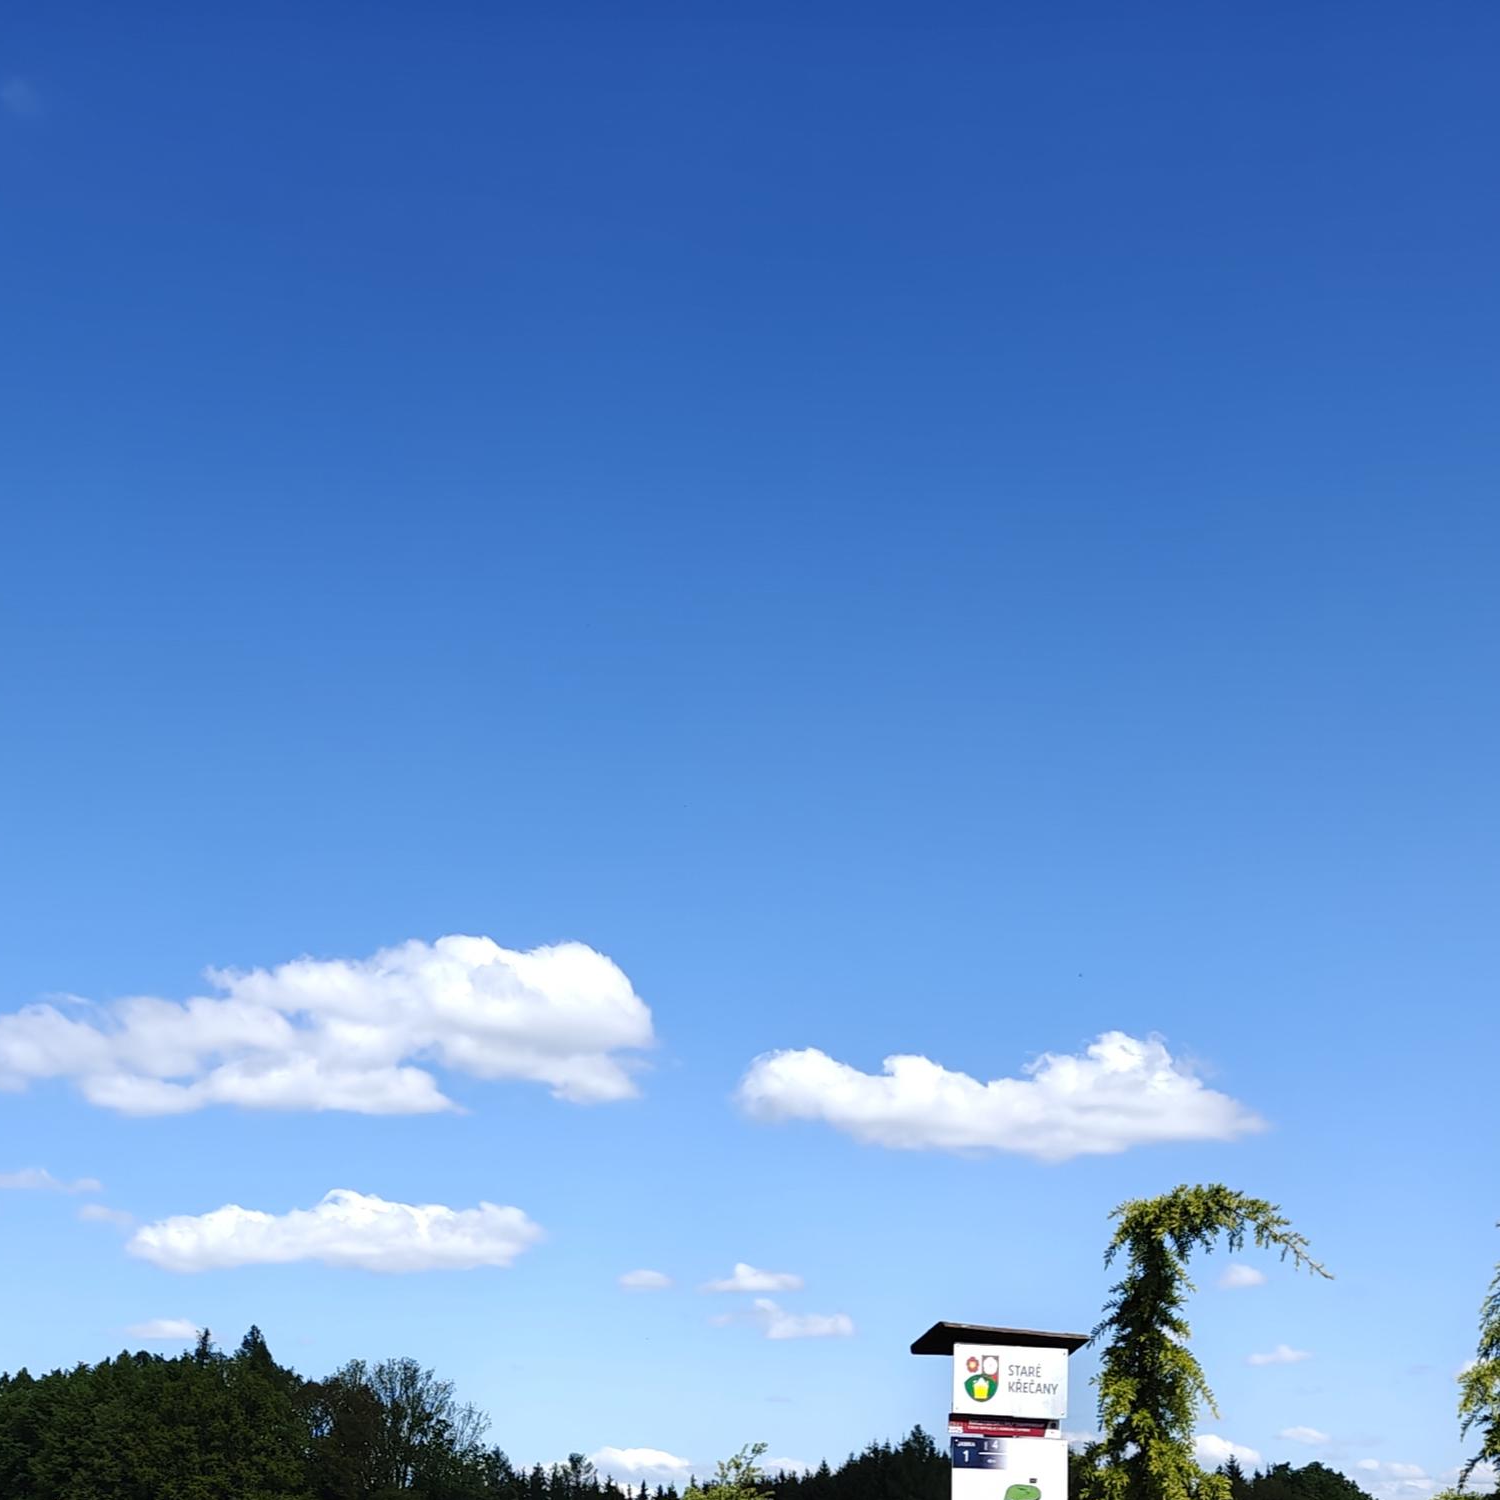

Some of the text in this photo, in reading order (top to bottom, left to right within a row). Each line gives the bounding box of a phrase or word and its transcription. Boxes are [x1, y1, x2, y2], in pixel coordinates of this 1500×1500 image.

[1008, 1363, 1042, 1378] STARÉ
[1008, 1378, 1059, 1395] KŘEČANY
[991, 1440, 999, 1449] 4
[962, 1449, 969, 1462] 1
